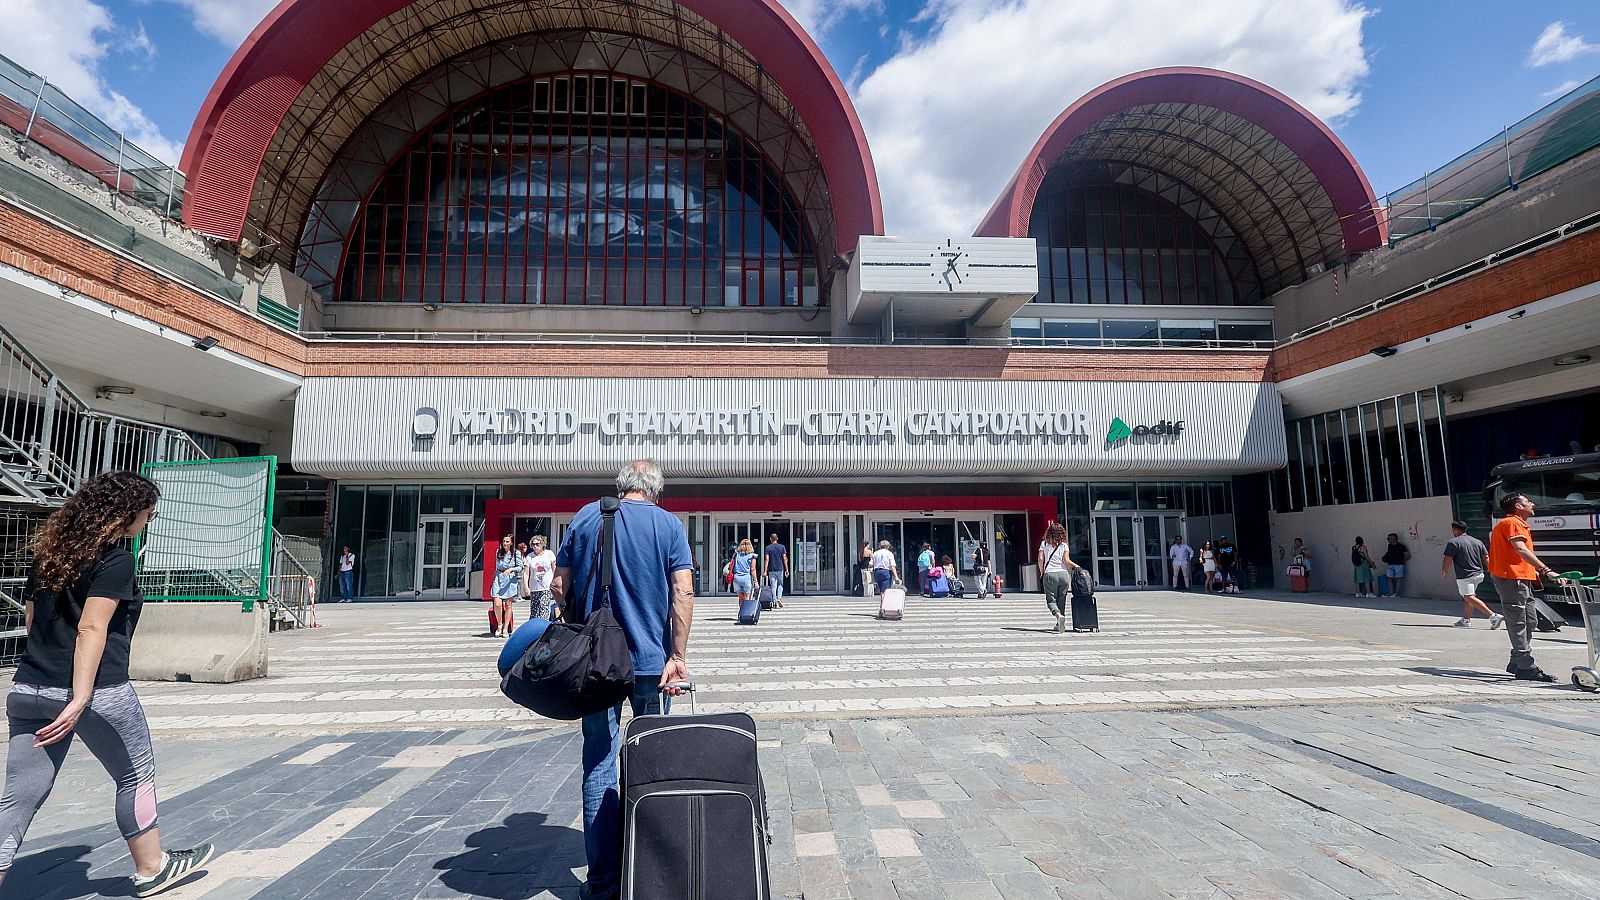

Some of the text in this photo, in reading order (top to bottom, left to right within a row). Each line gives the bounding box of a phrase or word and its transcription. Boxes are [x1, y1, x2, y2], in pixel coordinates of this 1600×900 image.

[906, 409, 1091, 436] CAMPOAMOR
[1132, 420, 1185, 436] adif
[1522, 457, 1575, 467] DEMOLICIONES
